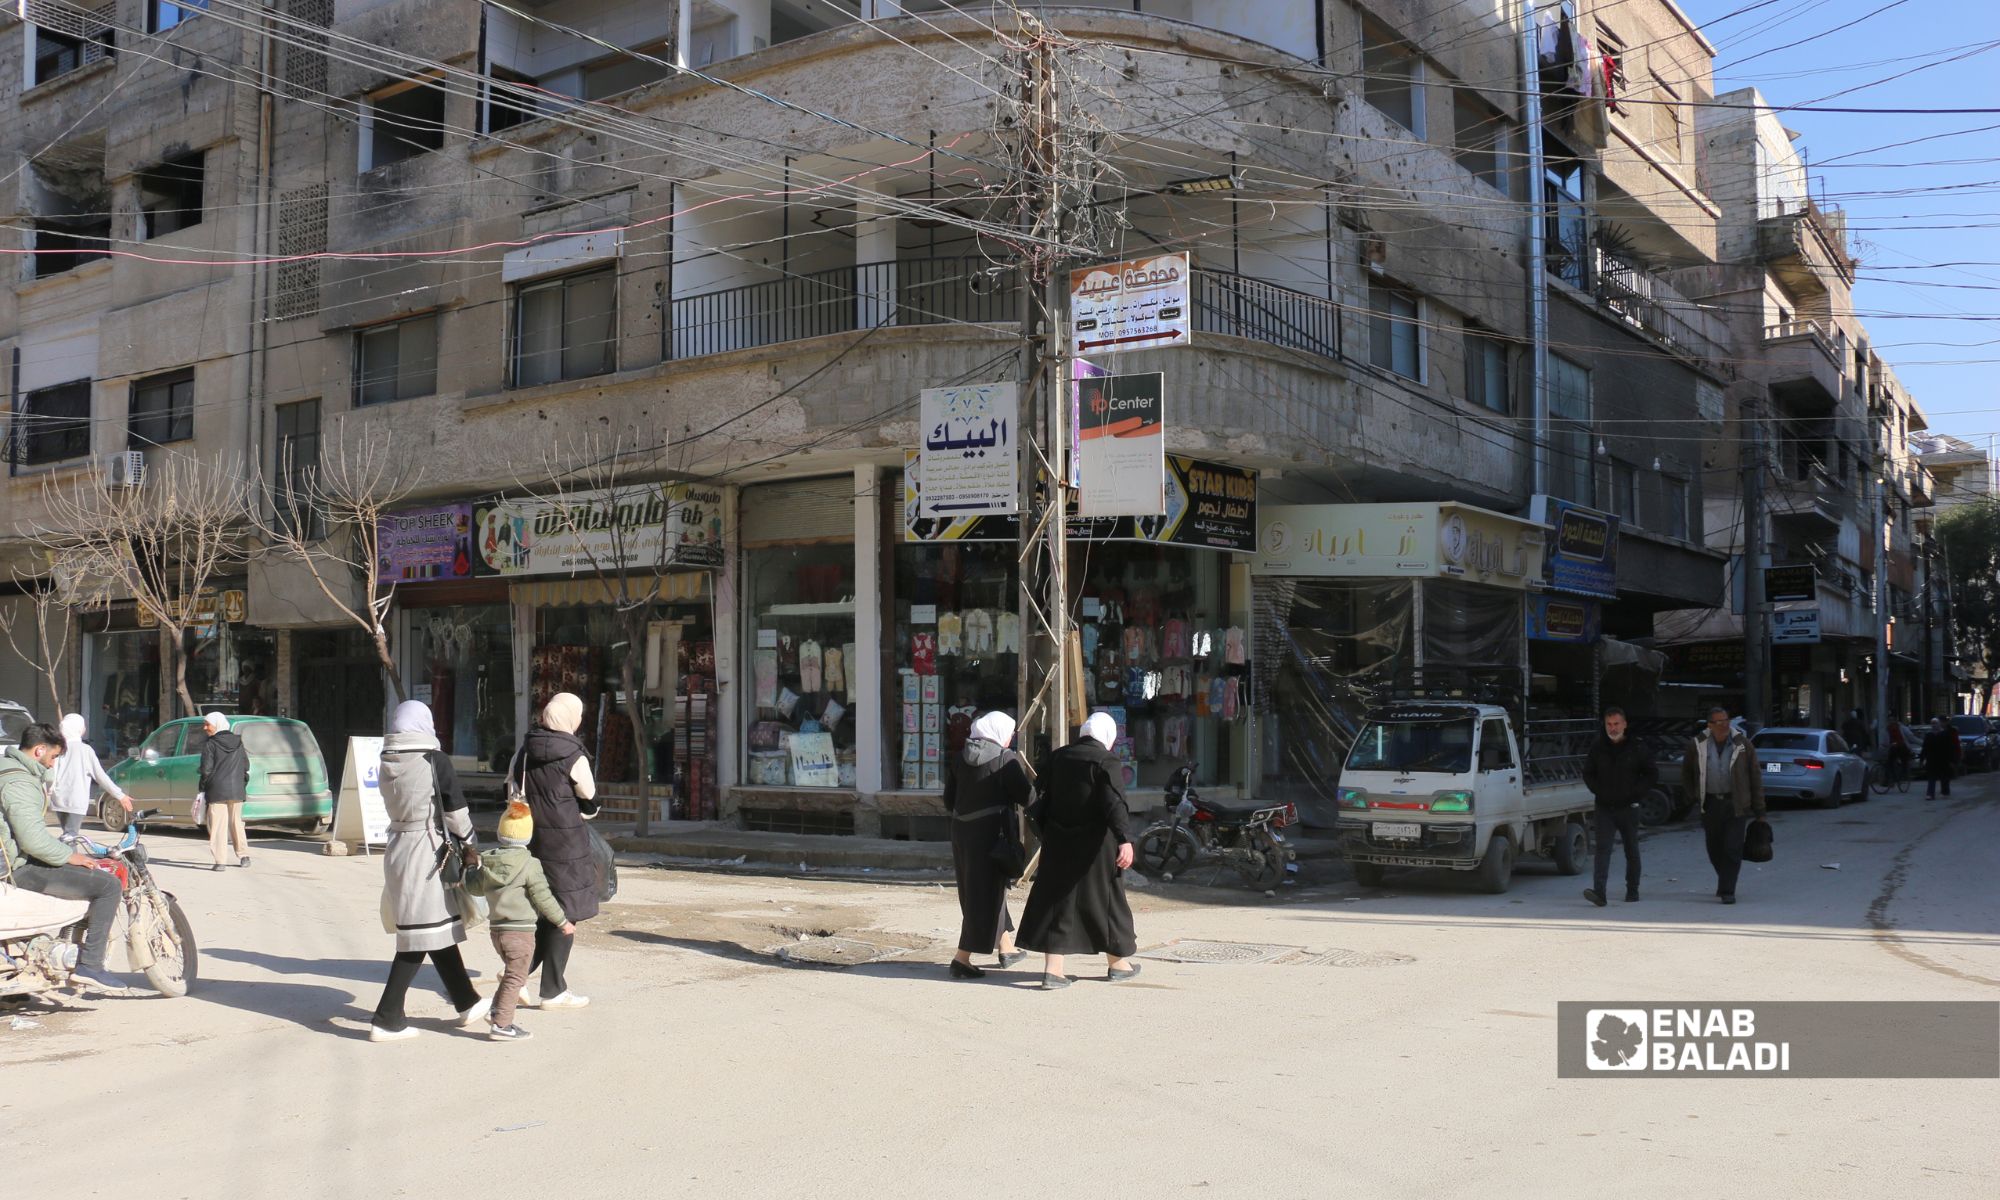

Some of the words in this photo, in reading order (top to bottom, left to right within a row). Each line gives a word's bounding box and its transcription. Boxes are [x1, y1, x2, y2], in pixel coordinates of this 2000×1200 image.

[1079, 276, 1121, 299] عبيد
[1125, 267, 1179, 290] محمصة
[1109, 396, 1154, 410] Center
[926, 417, 1007, 459] البيك
[1188, 468, 1225, 497] STAR
[1226, 474, 1255, 502] KIDS
[1197, 501, 1221, 517] نجوم
[1221, 502, 1249, 519] أطفال
[394, 517, 416, 532] TOP
[418, 513, 454, 528] SHEEK
